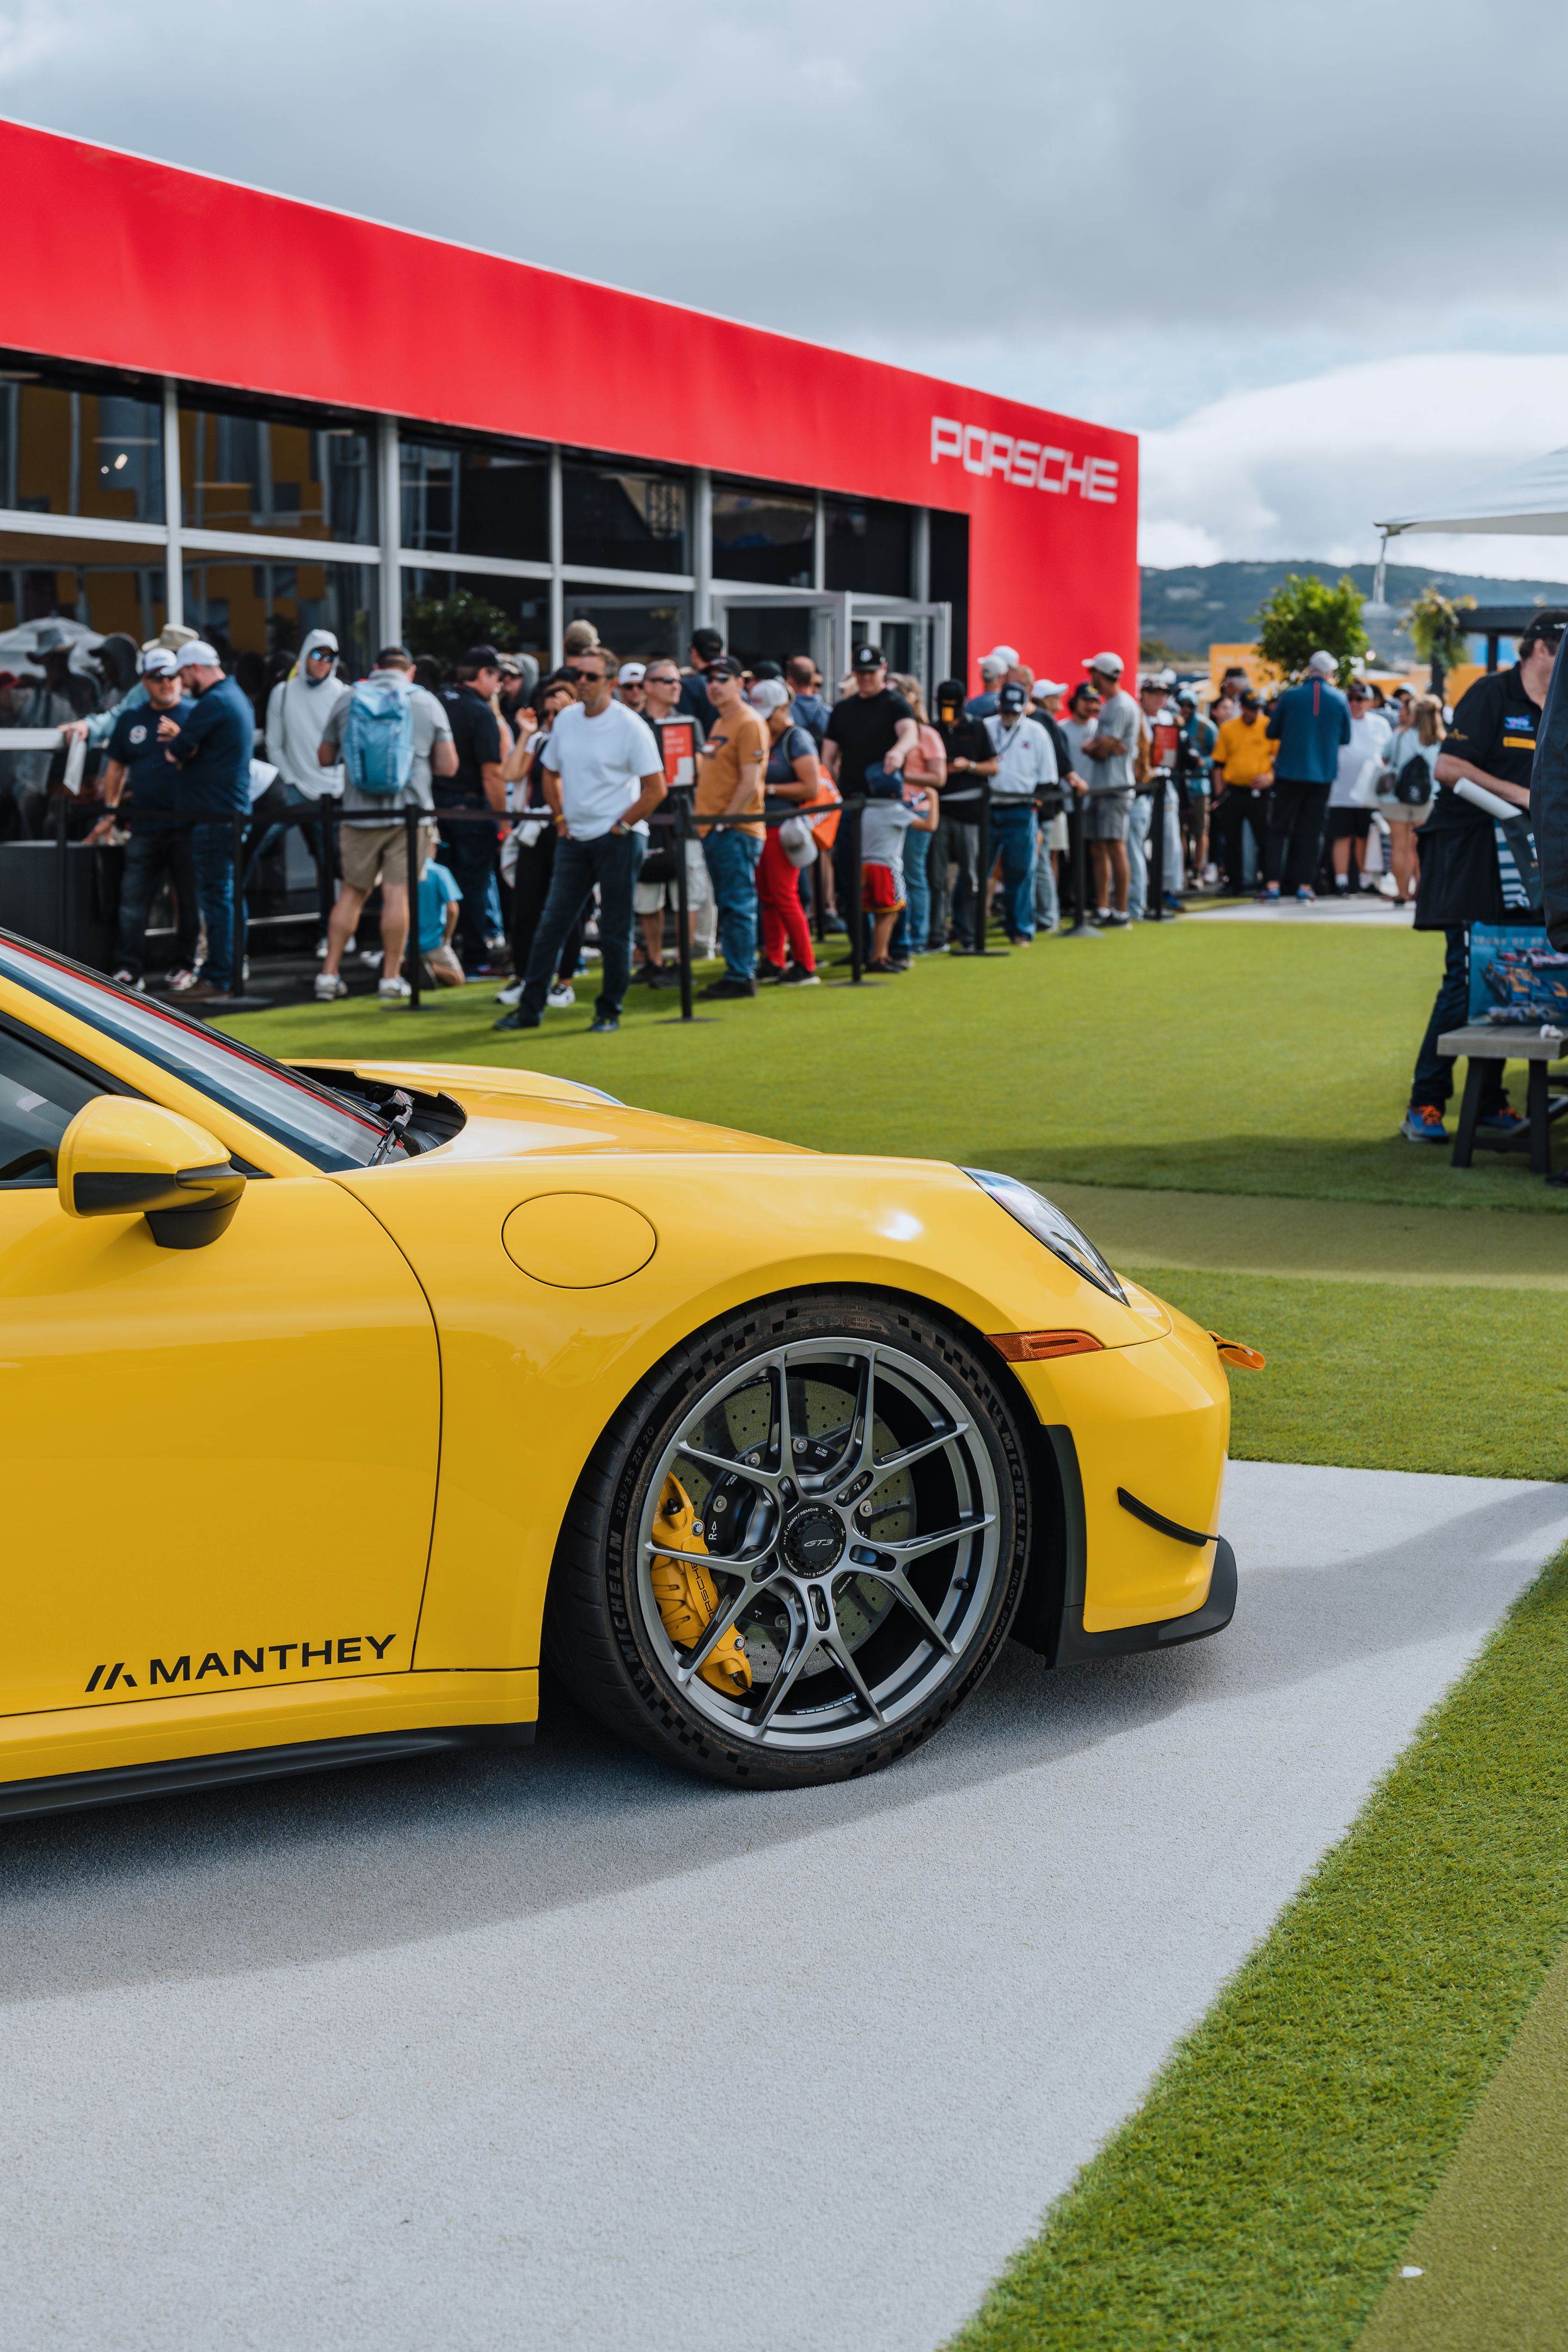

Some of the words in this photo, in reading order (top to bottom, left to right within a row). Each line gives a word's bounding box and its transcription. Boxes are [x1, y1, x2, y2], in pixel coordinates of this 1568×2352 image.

[930, 415, 1119, 504] PORSCHE
[616, 1467, 635, 1518] 255/35
[632, 1446, 645, 1466] ZR
[643, 1426, 654, 1444] 20
[1001, 1431, 1026, 1557] MICHELIN
[804, 1539, 834, 1547] GT3
[609, 1530, 639, 1662] MICHELIN
[690, 1563, 714, 1619] RSCHE
[1007, 1569, 1020, 1607] PILOT
[989, 1612, 1008, 1653] SPORT
[150, 1634, 397, 1685] MANTHEY
[973, 1655, 987, 1679] CUP
